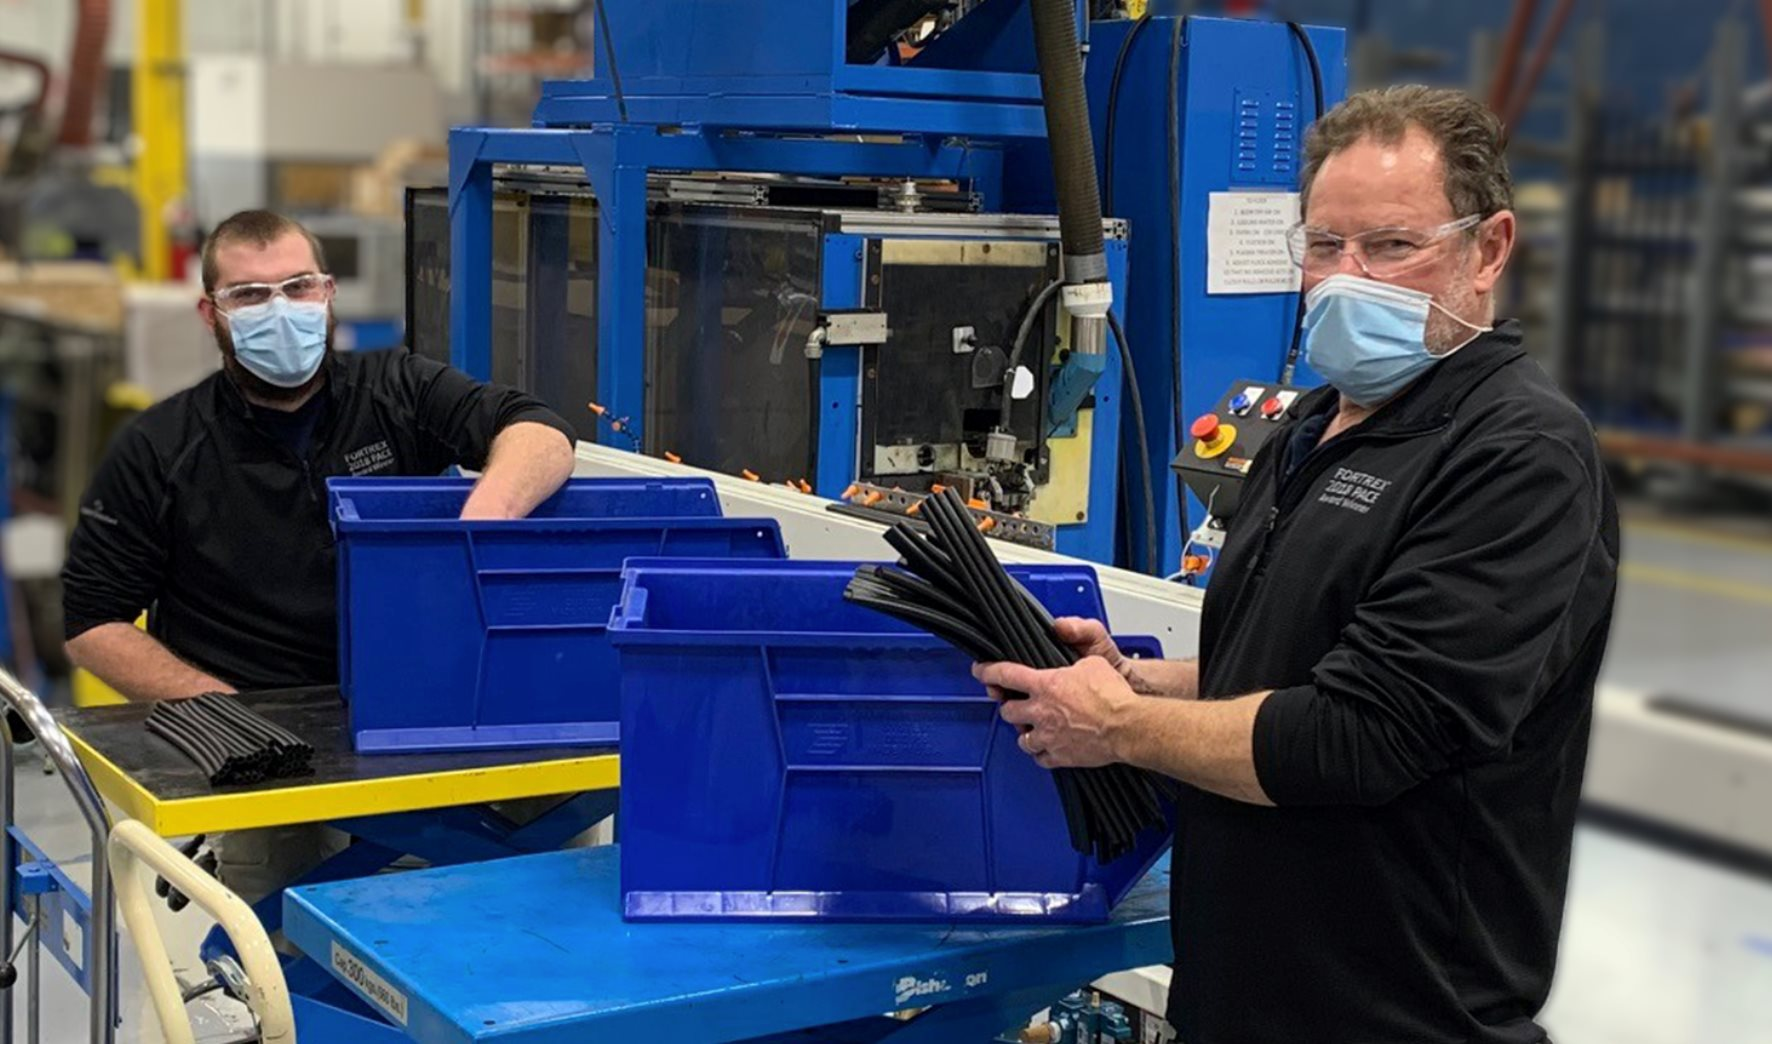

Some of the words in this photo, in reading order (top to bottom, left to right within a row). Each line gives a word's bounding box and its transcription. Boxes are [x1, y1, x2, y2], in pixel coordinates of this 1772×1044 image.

[343, 440, 388, 463] FORTREX
[1351, 486, 1381, 504] PACE
[347, 958, 365, 987] 300
